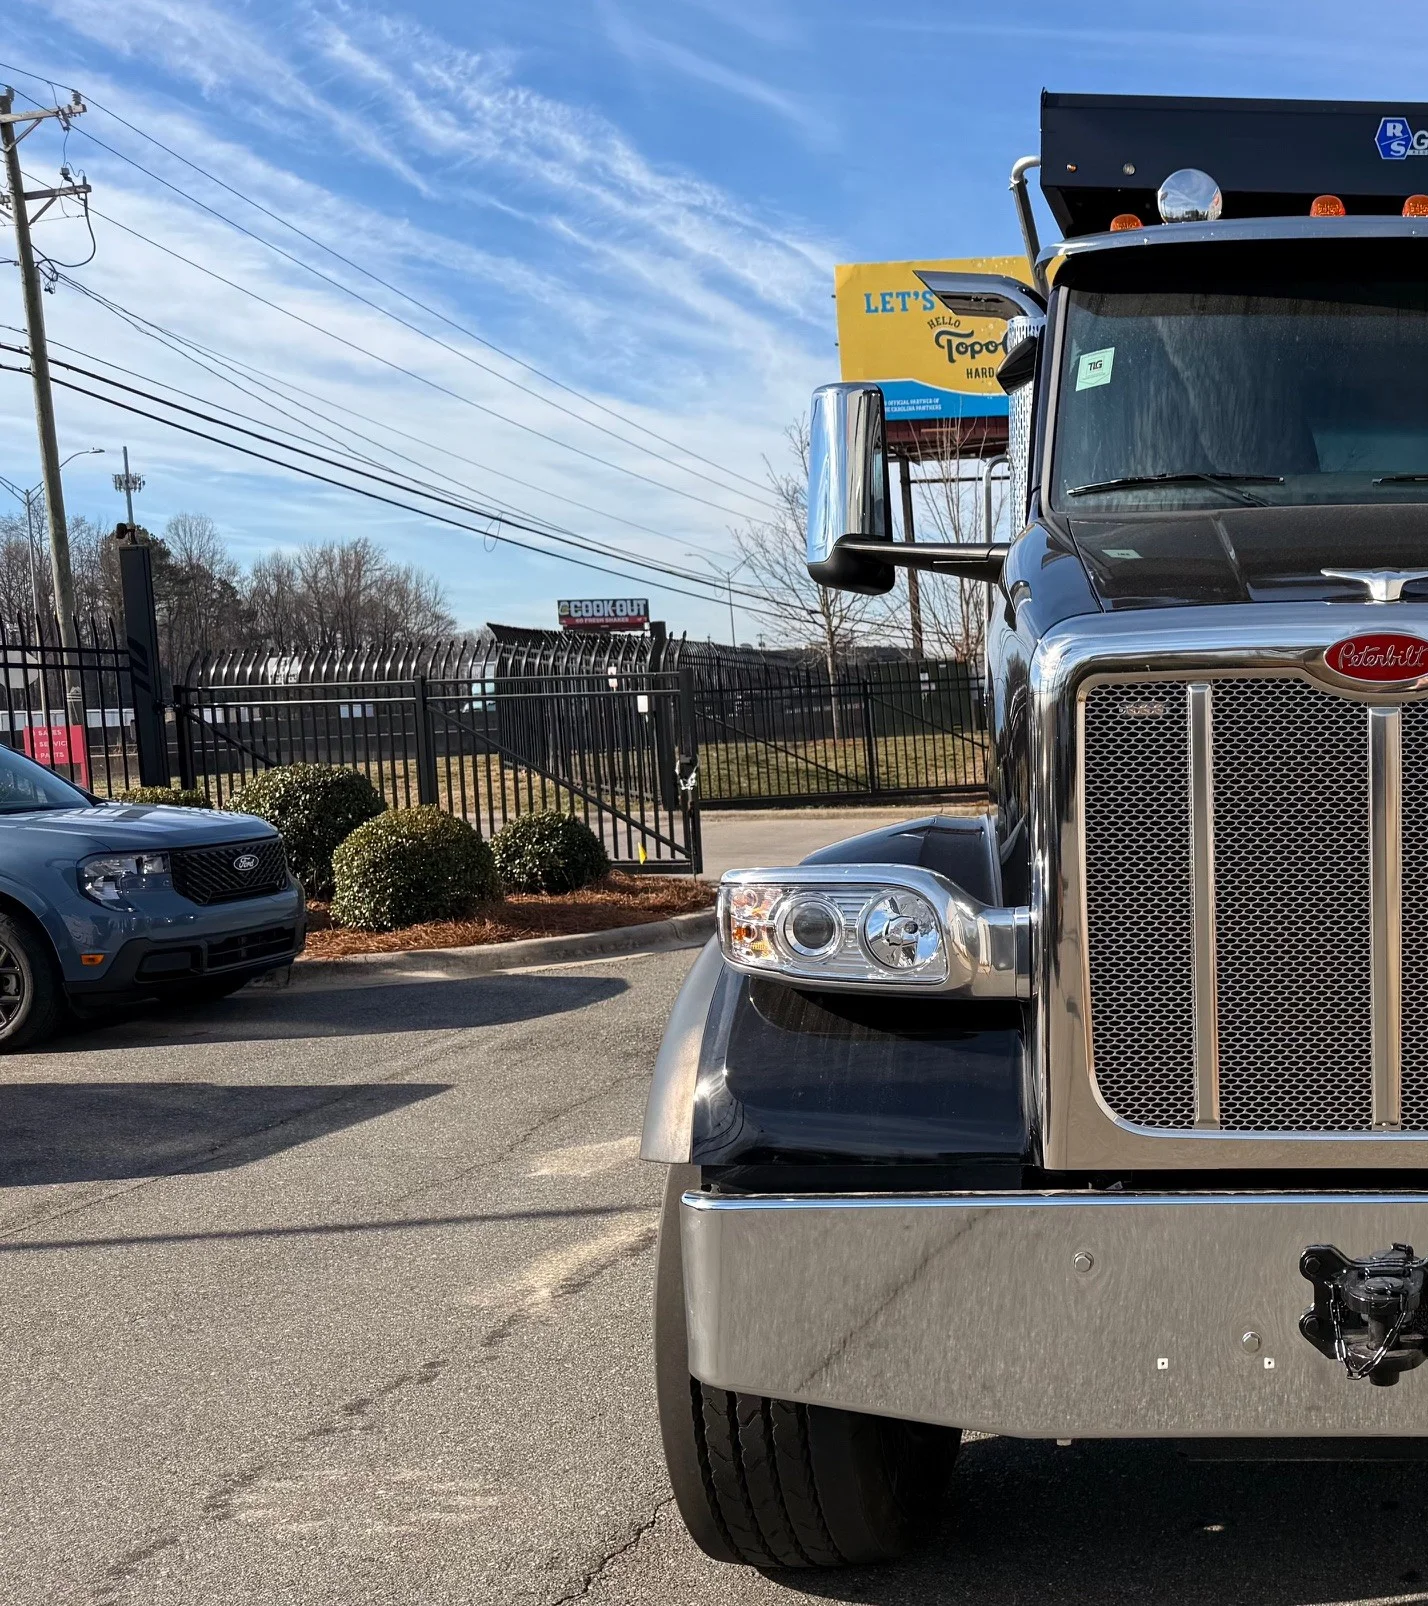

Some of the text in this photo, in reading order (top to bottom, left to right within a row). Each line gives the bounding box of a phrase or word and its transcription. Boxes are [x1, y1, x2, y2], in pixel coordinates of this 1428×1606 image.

[1386, 122, 1403, 137] R
[1390, 141, 1406, 156] S
[864, 290, 936, 314] LET'S
[927, 316, 961, 330] HELLO
[966, 367, 995, 379] HARD
[239, 857, 255, 868] Ford
